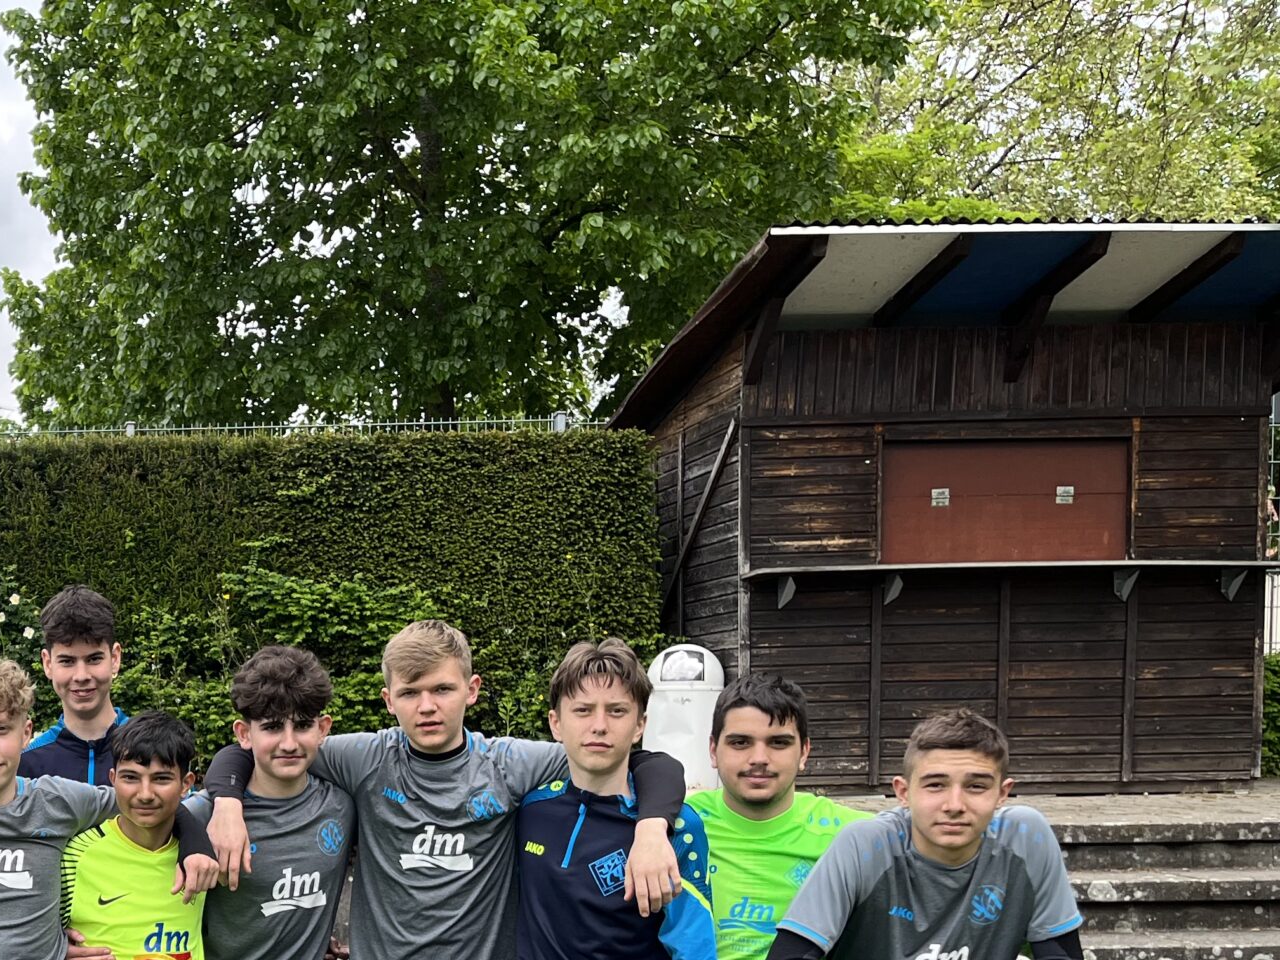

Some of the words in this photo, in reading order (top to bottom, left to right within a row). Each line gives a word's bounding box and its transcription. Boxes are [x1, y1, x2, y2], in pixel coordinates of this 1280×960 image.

[381, 786, 408, 805] JAKO
[412, 825, 465, 856] dm
[524, 840, 545, 856] JAKO
[272, 867, 321, 901] dm
[729, 896, 775, 922] dm
[143, 922, 190, 953] dm
